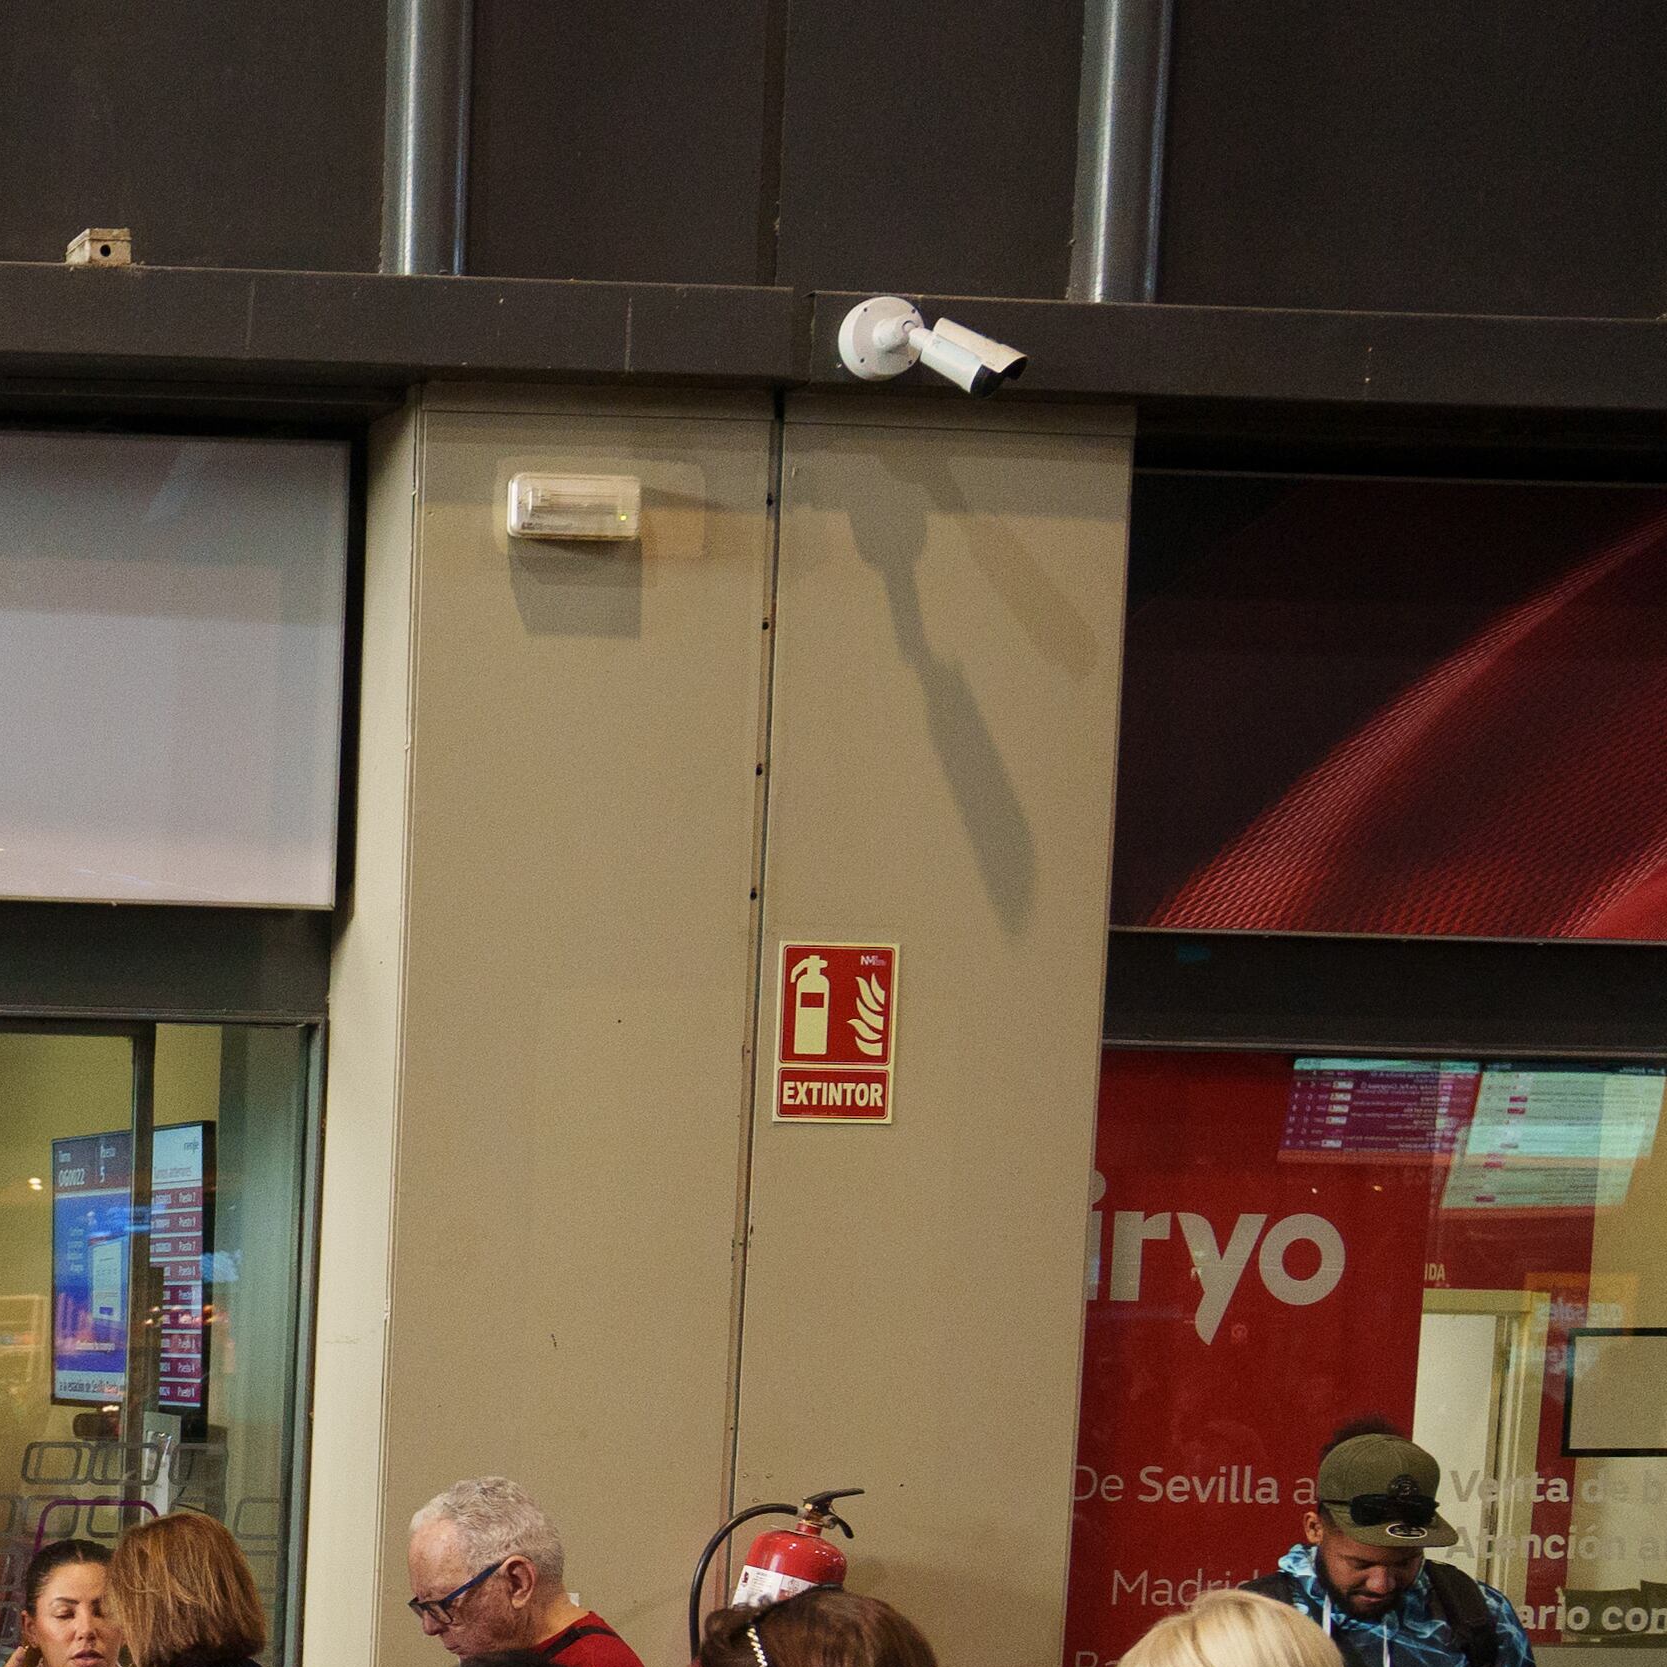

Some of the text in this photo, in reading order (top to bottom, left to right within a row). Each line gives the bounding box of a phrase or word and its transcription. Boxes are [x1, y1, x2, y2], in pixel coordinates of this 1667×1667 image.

[782, 1081, 884, 1107] EXTINTOR
[1083, 1169, 1346, 1346] iryo
[1138, 1464, 1279, 1504] Sevilla
[1293, 1476, 1318, 1505] a
[1449, 1470, 1569, 1503] Venta
